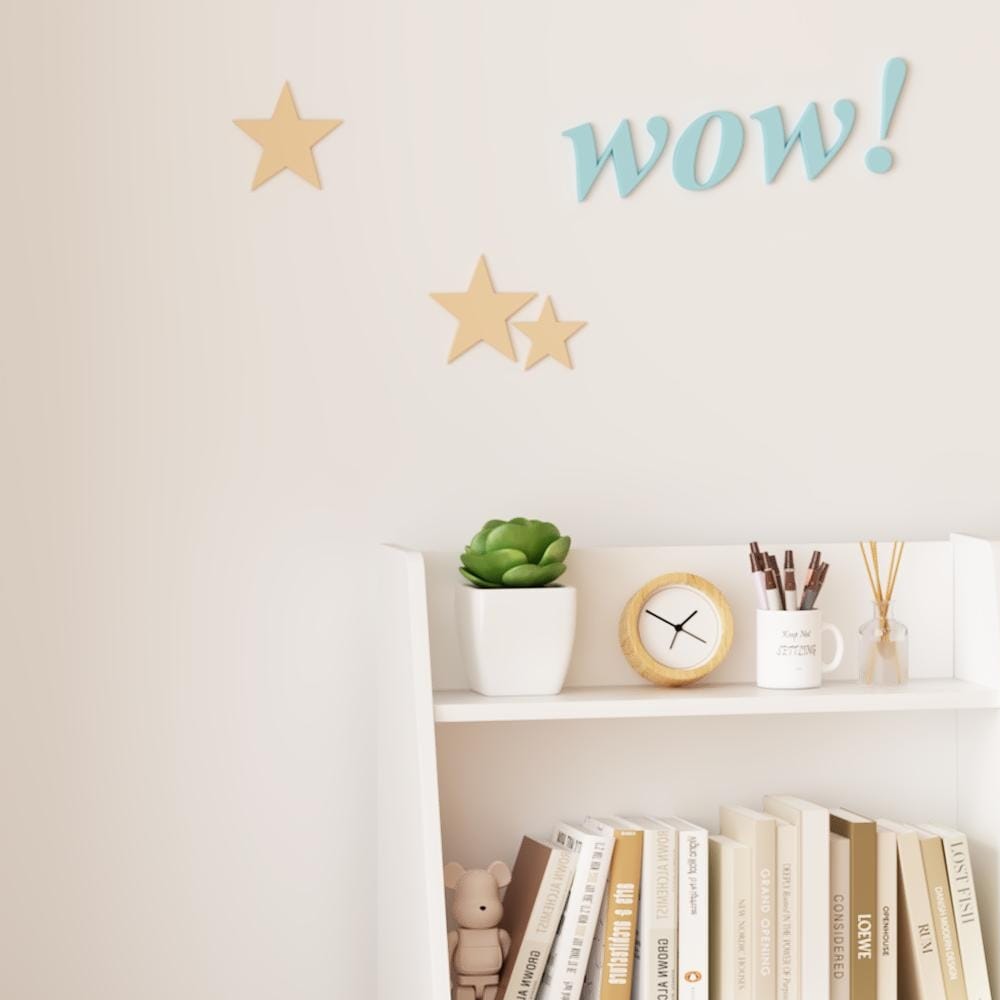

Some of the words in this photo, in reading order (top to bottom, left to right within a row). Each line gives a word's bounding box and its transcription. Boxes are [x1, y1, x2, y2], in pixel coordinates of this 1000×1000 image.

[561, 55, 909, 203] wow!
[950, 841, 968, 884] LOST
[760, 868, 771, 913] GRAND
[957, 888, 975, 925] FISH
[760, 918, 771, 976] OPENING
[833, 894, 844, 980] CONSIDERED
[857, 914, 872, 960] LOEWE
[882, 906, 890, 956] OPENHOUSE
[918, 923, 933, 954] RUM
